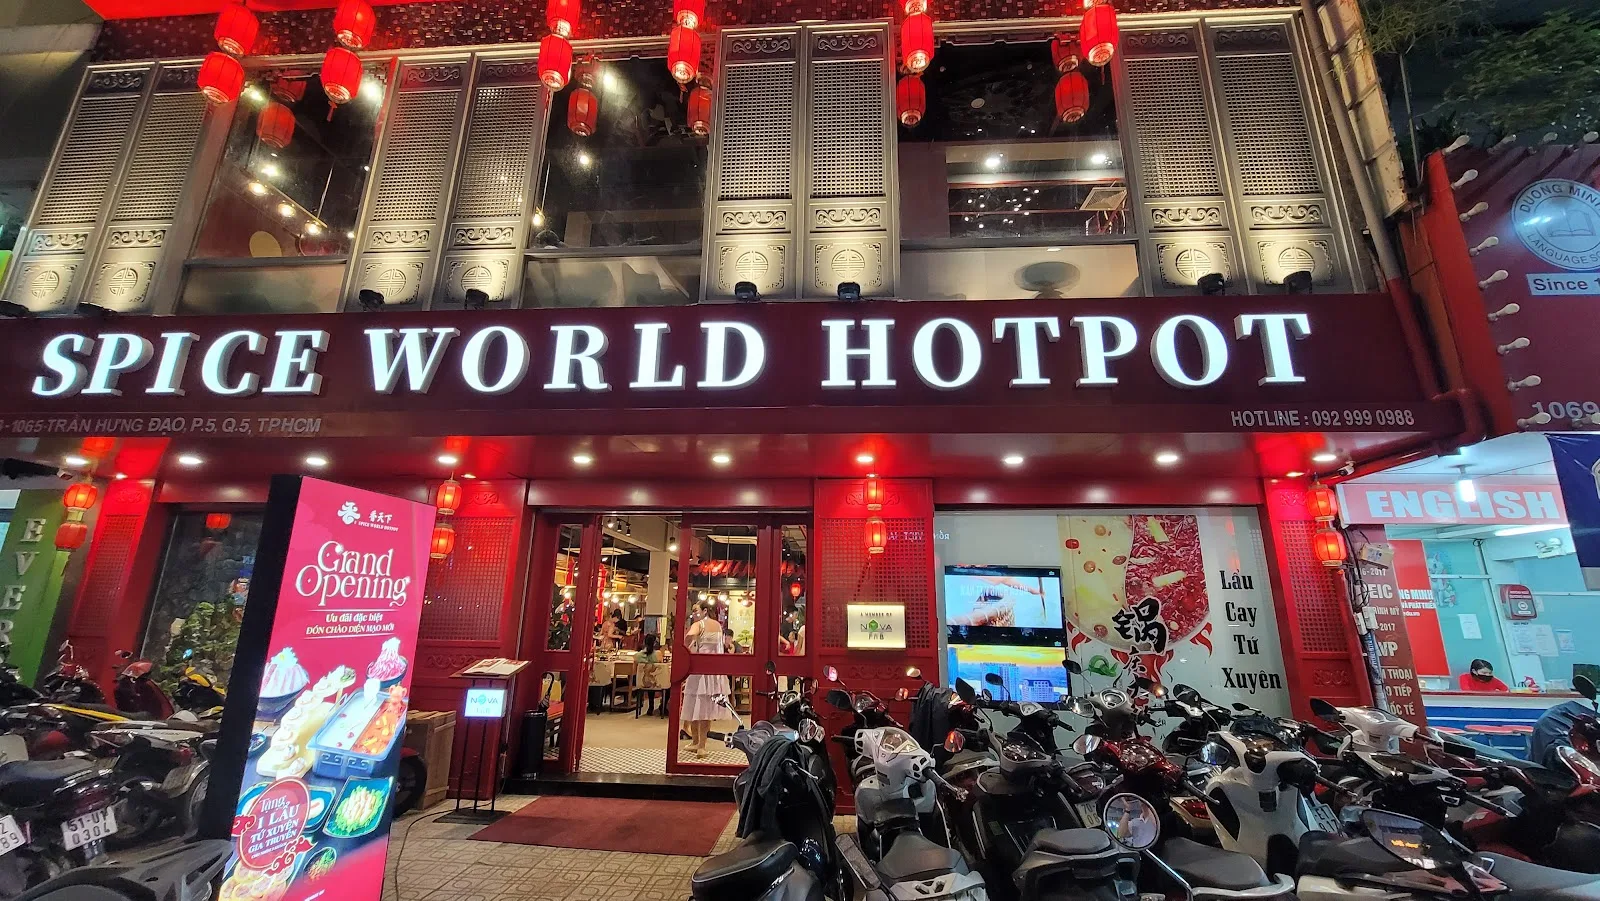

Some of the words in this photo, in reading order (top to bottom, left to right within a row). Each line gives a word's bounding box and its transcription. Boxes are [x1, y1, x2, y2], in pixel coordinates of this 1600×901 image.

[1520, 184, 1563, 214] DUONG
[1526, 233, 1590, 265] LANGUAGE
[1533, 278, 1589, 291] Since
[32, 329, 331, 397] SPICE
[364, 321, 768, 394] WORLD
[820, 313, 1313, 389] HOTPOT
[257, 417, 322, 433] TPHCM
[1230, 410, 1301, 427] HOTLINE
[1312, 410, 1342, 427] 092
[1343, 409, 1373, 426] 999
[1376, 409, 1415, 426] 0988
[1366, 490, 1560, 519] ENGLISH
[317, 540, 394, 577] Grand
[295, 564, 411, 607] Opening
[1219, 569, 1254, 590] Lẩu
[861, 620, 892, 632] NOVA
[1225, 601, 1257, 627] Cay
[1233, 635, 1260, 655] Tứ
[1221, 667, 1282, 694] Xuyên
